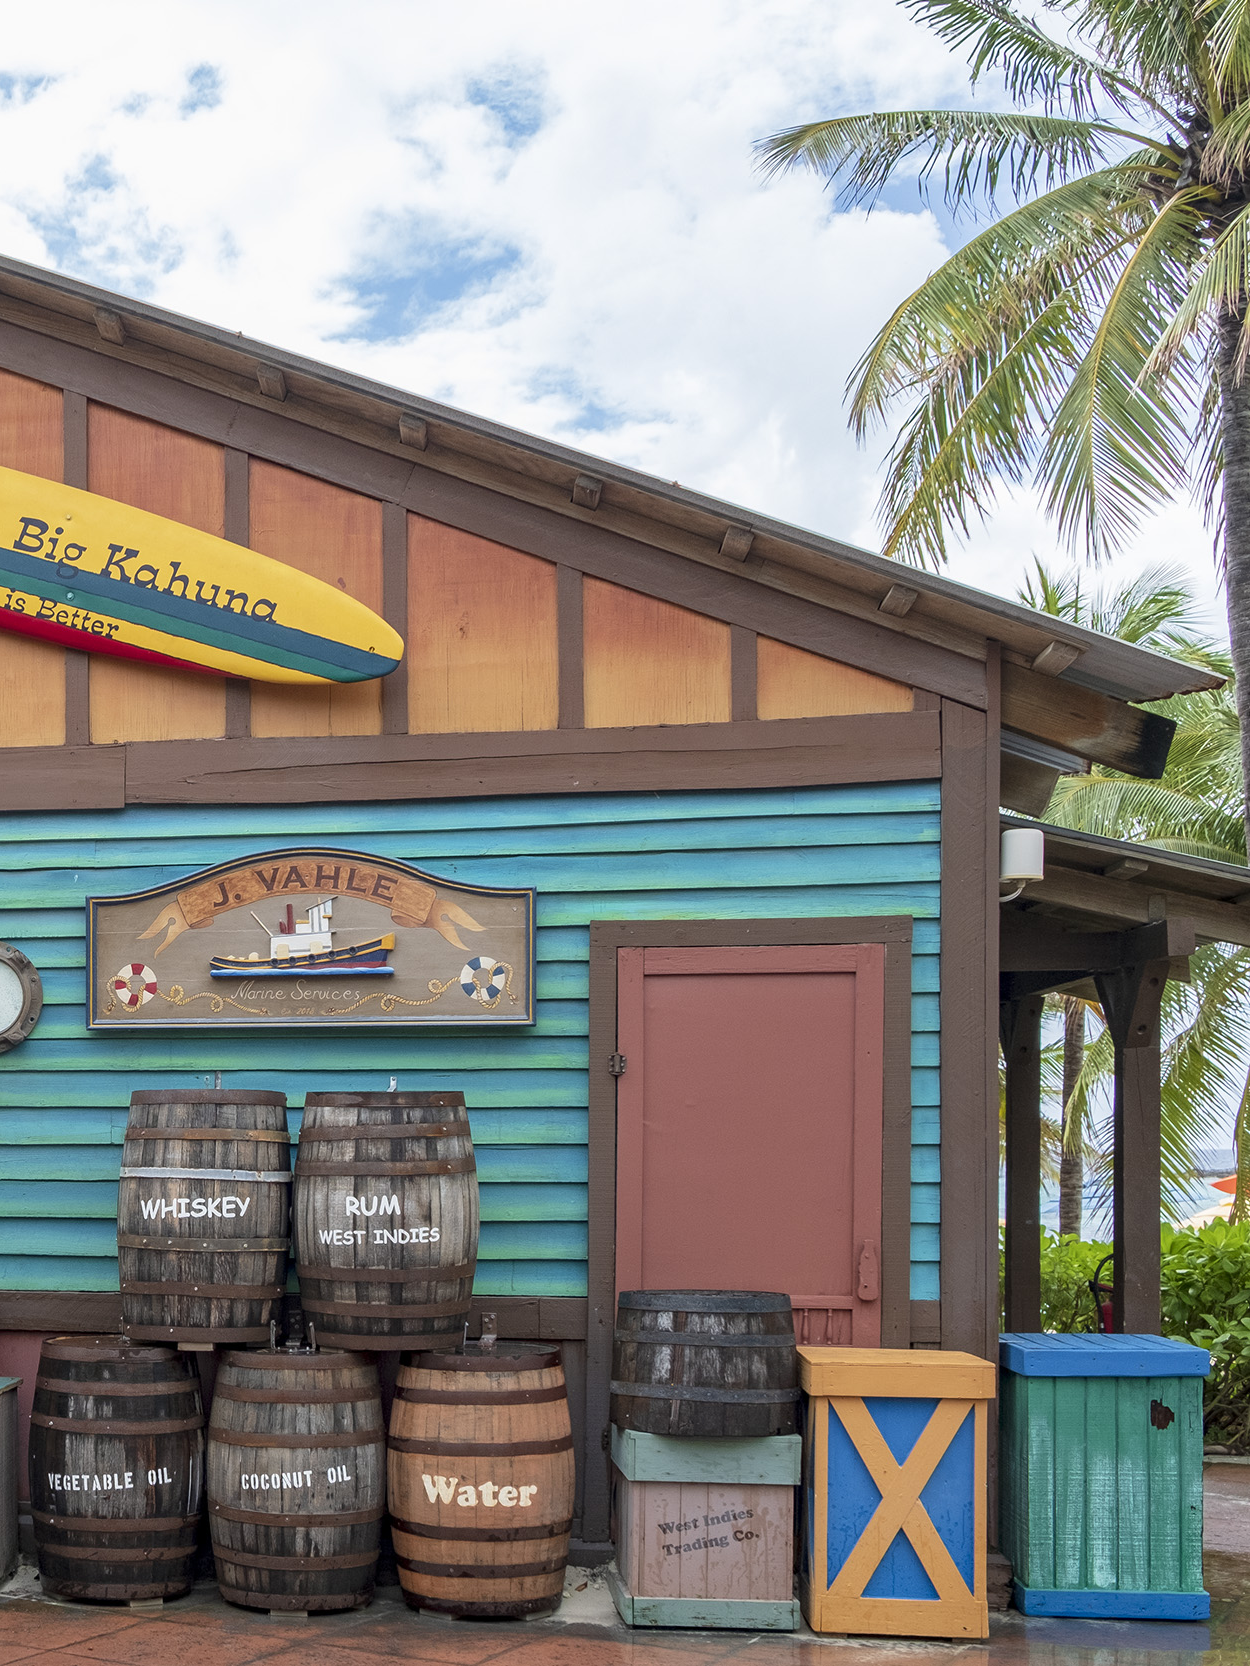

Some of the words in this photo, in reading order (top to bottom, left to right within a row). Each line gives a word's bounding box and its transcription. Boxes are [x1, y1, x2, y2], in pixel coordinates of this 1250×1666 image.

[13, 516, 87, 579] Big
[100, 544, 278, 624] Kahuna
[5, 588, 27, 613] is
[35, 596, 120, 639] Better
[213, 882, 241, 908] J.
[255, 865, 398, 902] VAHLE
[231, 980, 286, 1000] Marine
[291, 979, 360, 1000] Services
[141, 1196, 250, 1220] WHISKEY
[346, 1194, 401, 1216] RUM
[319, 1229, 366, 1245] WEST
[373, 1227, 440, 1244] INDIES
[48, 1471, 134, 1491] VEGETABLE
[147, 1467, 172, 1485] OIL
[241, 1470, 313, 1490] COCONUT
[327, 1464, 351, 1484] OIL
[421, 1474, 538, 1507] Water
[658, 1518, 699, 1535] West
[702, 1509, 754, 1527] Indies
[662, 1535, 730, 1556] Trading
[733, 1530, 760, 1541] Co.
